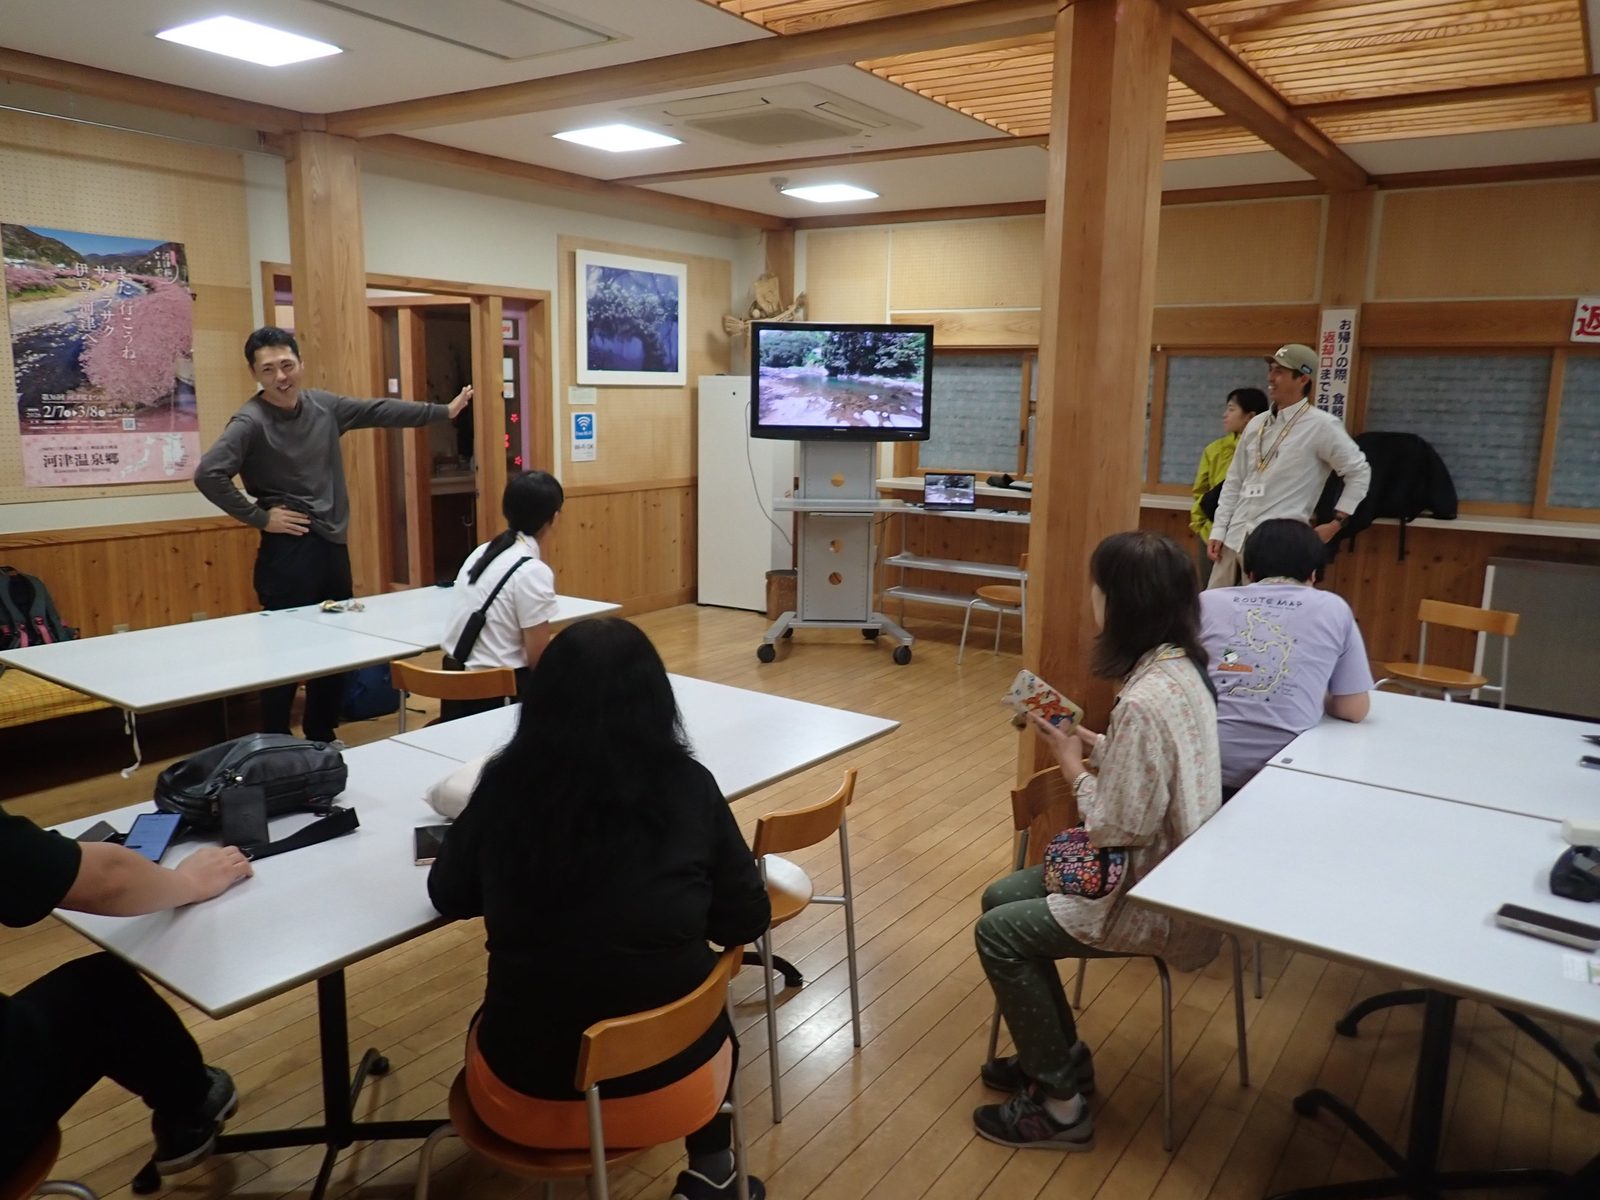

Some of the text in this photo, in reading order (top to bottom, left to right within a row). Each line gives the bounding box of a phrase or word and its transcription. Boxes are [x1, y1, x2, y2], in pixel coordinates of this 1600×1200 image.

[94, 265, 115, 338] サクラサク
[43, 405, 65, 418] 2/7
[78, 405, 98, 418] 3/8
[42, 453, 119, 468] 河津温泉郷
